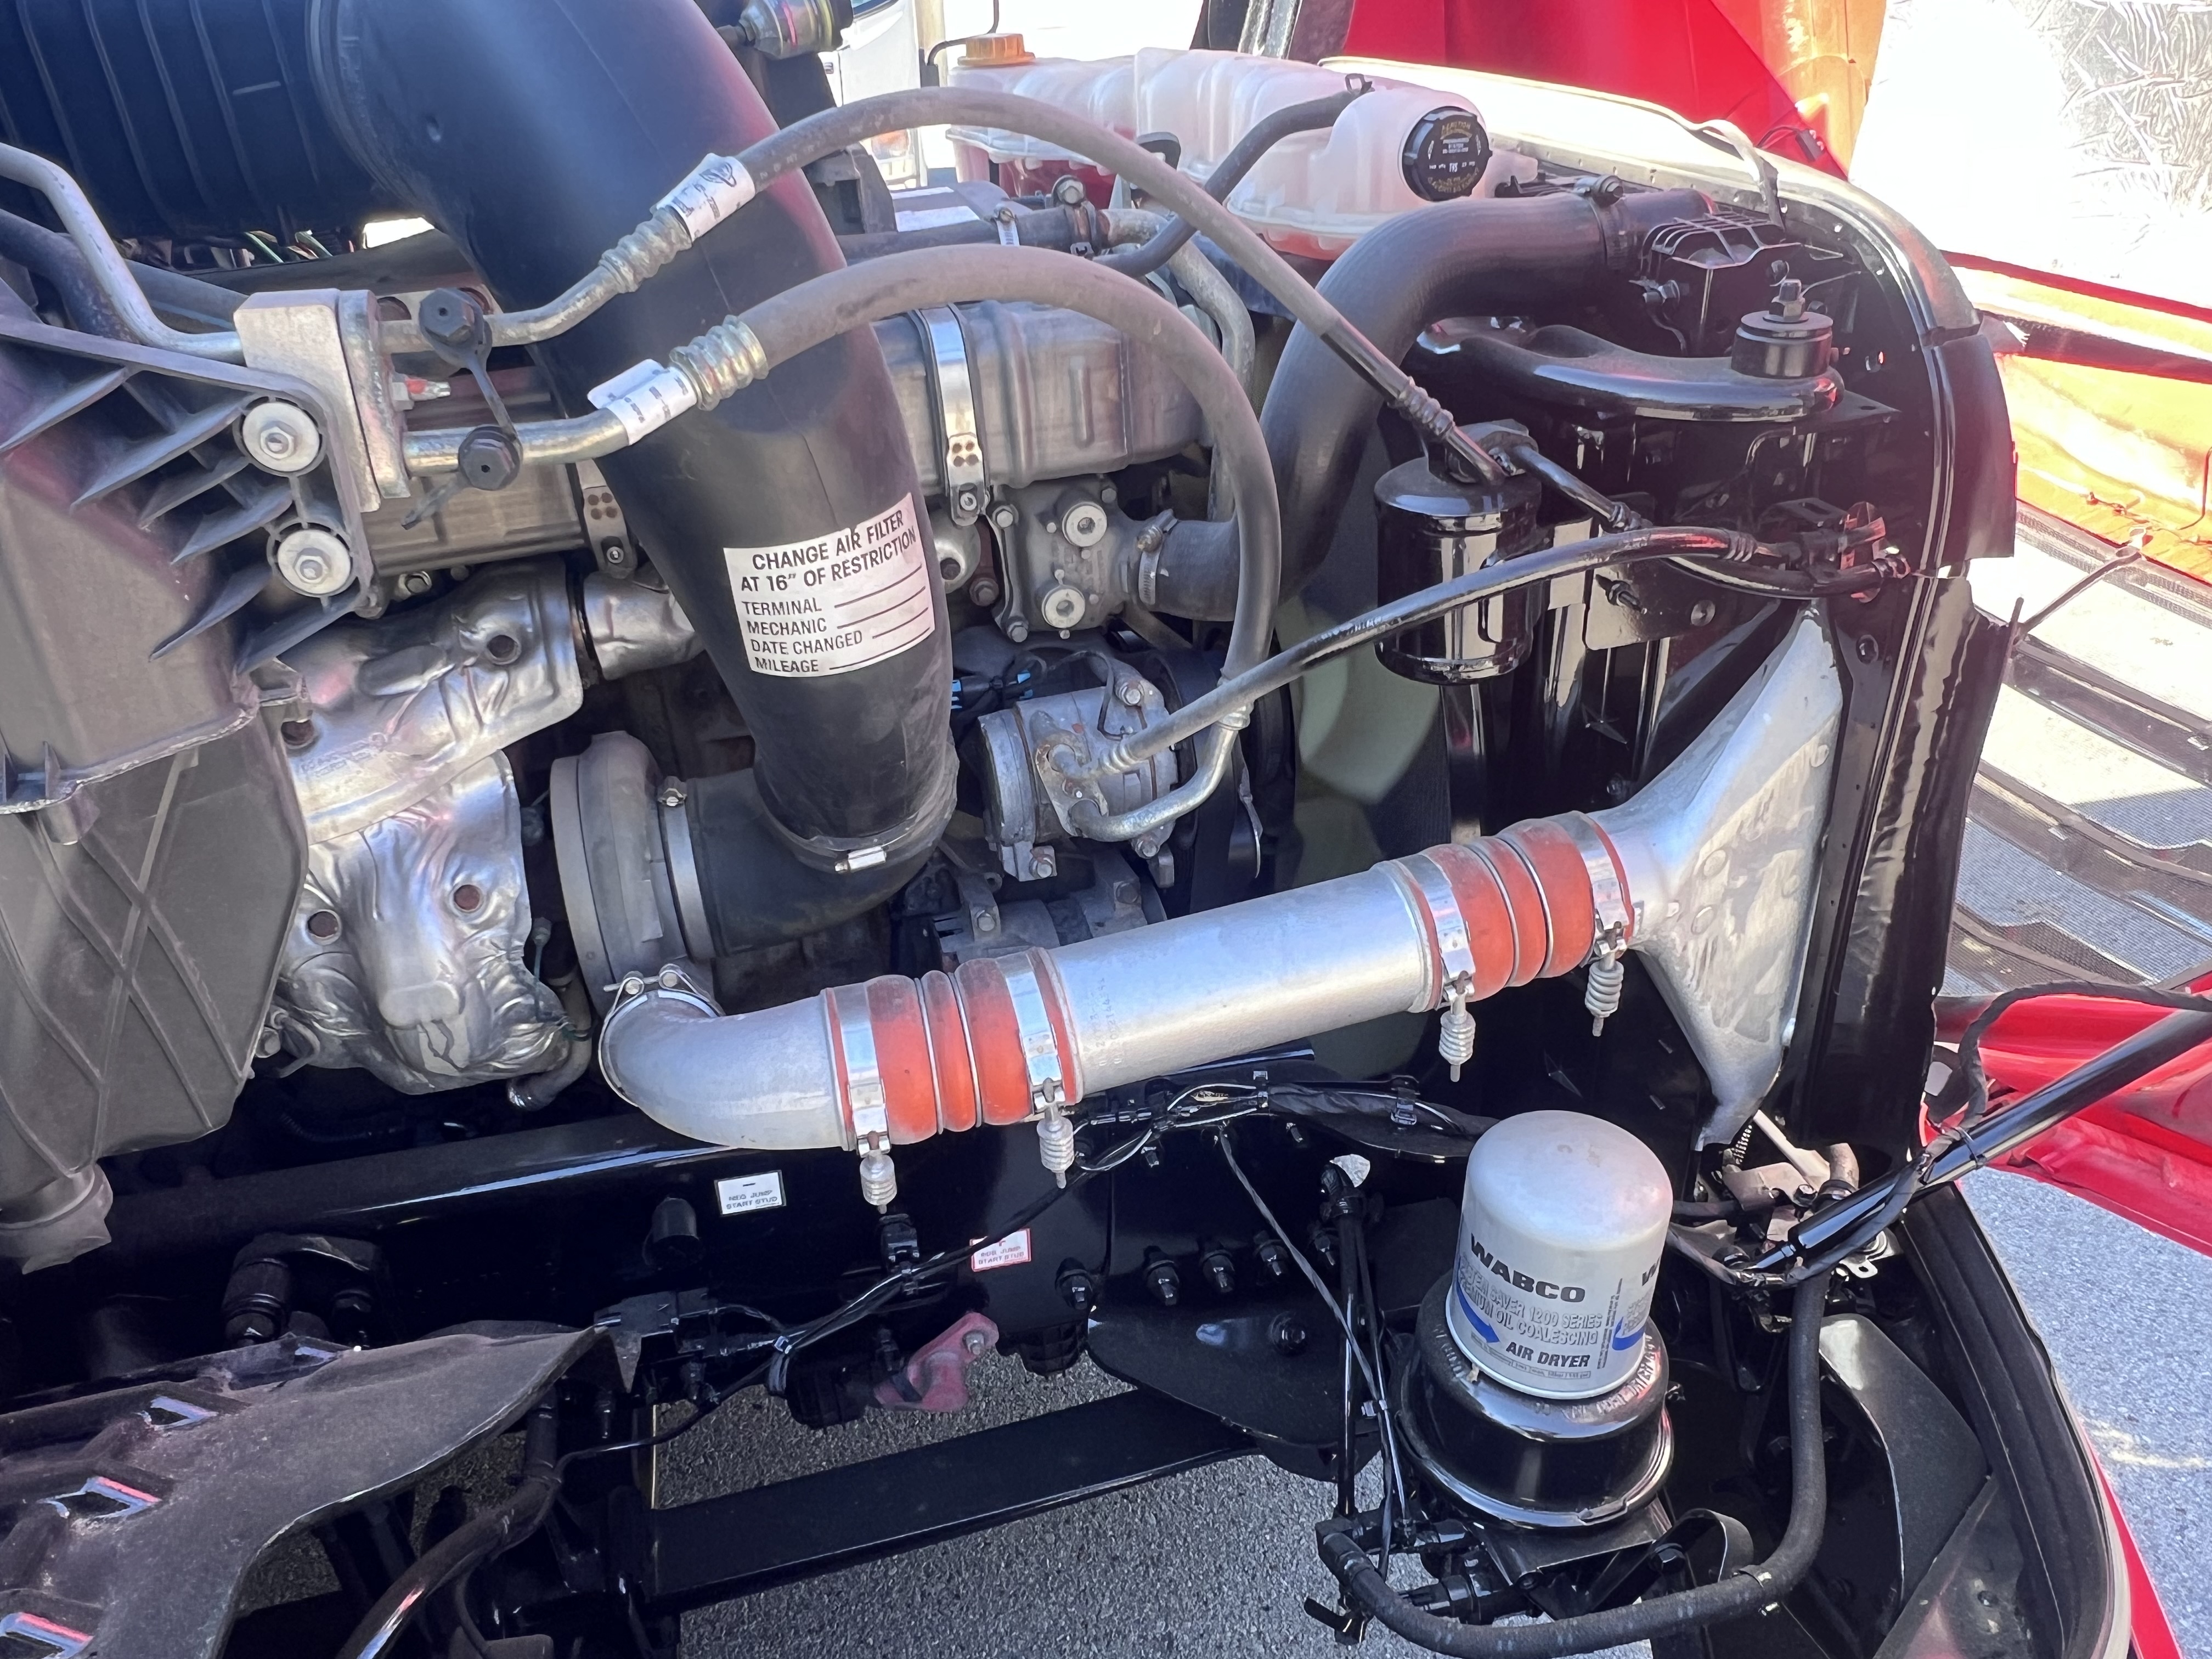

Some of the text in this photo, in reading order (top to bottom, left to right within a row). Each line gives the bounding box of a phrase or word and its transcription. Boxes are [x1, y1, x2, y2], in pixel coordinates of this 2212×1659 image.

[752, 510, 903, 570] CHANGE AIR FILTER
[741, 576, 759, 591] AT
[804, 568, 826, 586] OF
[832, 527, 916, 581] RESTRICTION
[741, 597, 822, 616] TERMINAL
[747, 617, 827, 636] MECHANIC
[751, 630, 862, 655] DATE CHANGED
[754, 656, 820, 673] MILEAGE
[1471, 1233, 1585, 1303] WABCO
[1490, 1284, 1525, 1318] SAVER
[1529, 1306, 1559, 1327] 1200
[1562, 1313, 1603, 1329] SERIES
[1496, 1308, 1514, 1330] OIL
[1516, 1319, 1598, 1346] COALESCING
[1505, 1341, 1534, 1361] AIR
[1537, 1351, 1591, 1368] DRYER
